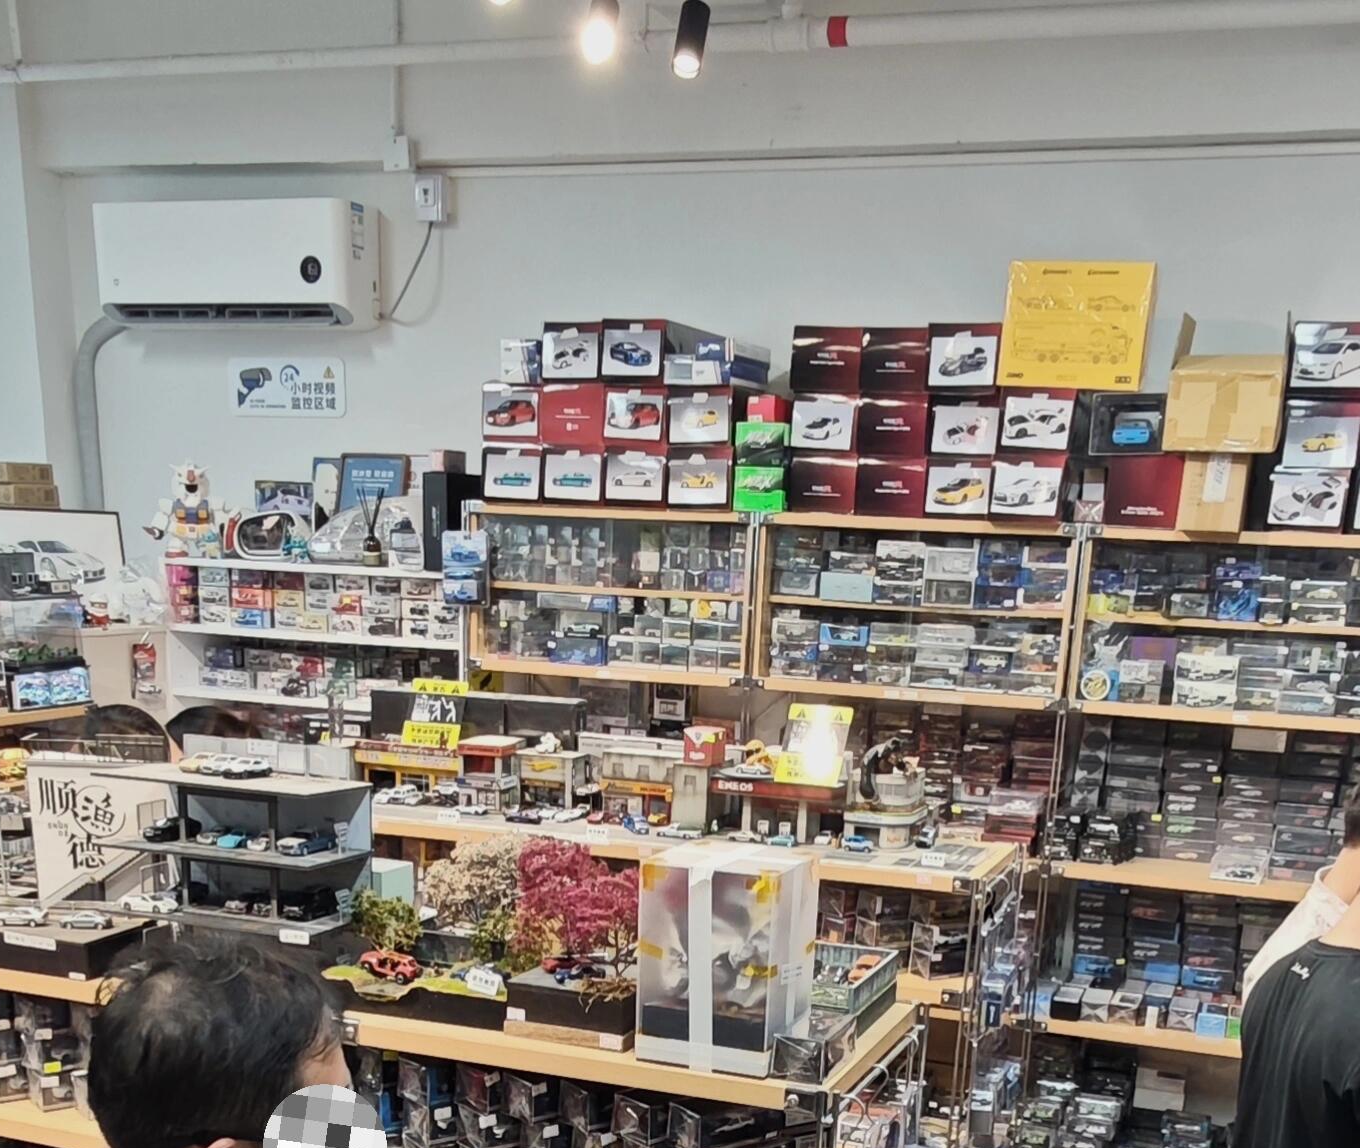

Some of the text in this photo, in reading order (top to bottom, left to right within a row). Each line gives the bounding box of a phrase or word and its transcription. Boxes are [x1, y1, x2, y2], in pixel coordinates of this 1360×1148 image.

[291, 382, 335, 395] 小时视频
[291, 397, 336, 410] 监控区域
[718, 780, 753, 792] ENEOS
